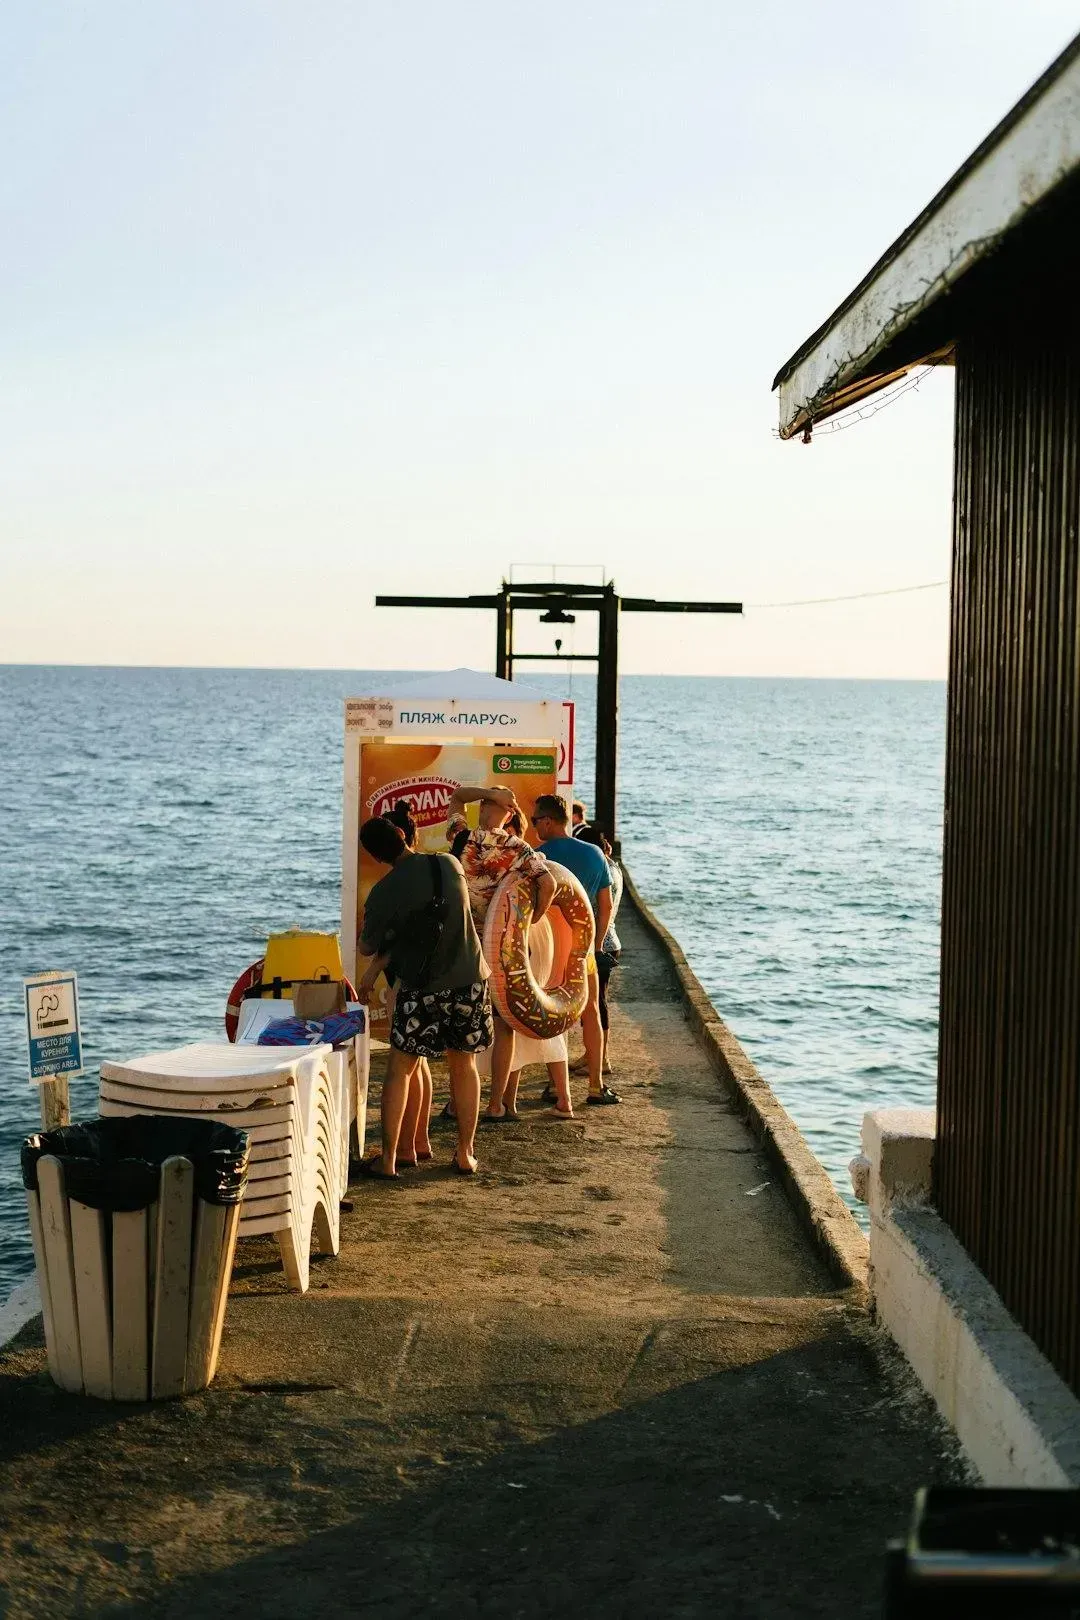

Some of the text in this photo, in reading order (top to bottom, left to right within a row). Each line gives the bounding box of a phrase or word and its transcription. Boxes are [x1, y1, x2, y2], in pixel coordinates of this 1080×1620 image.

[400, 712, 517, 726] ПЛЯЖ «ПАРУС»
[37, 1035, 72, 1049] МЕСТО ДЛЯ
[41, 1045, 69, 1058] КУРЕНИЯ
[33, 1060, 79, 1075] SMOKING AREA
